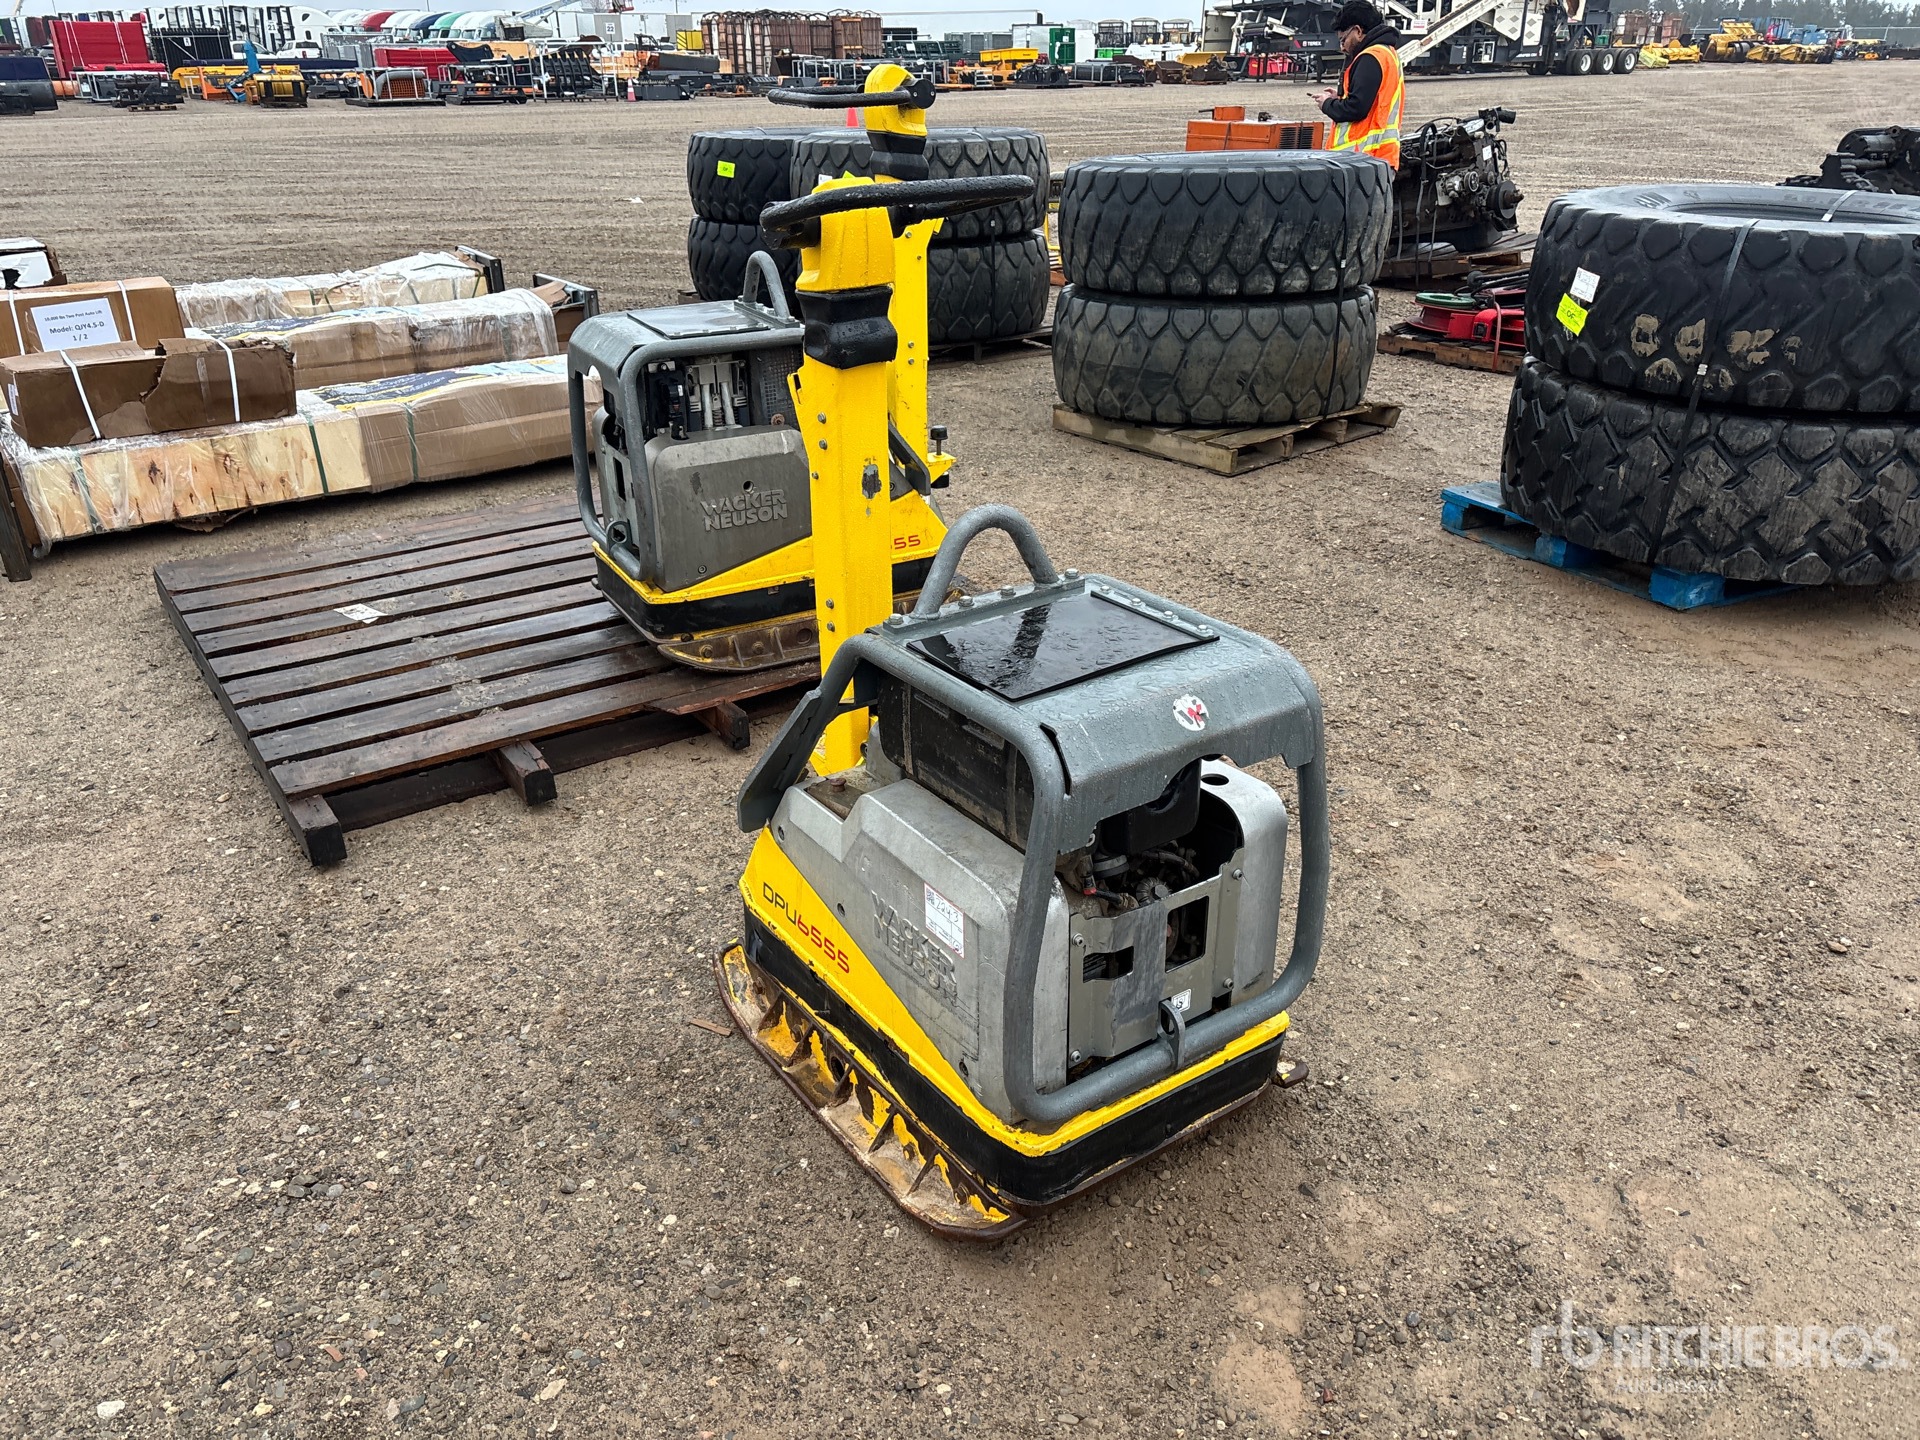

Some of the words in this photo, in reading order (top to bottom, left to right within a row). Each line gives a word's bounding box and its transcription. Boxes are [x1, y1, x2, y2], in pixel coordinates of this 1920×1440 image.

[49, 326, 74, 334] Model:
[74, 321, 105, 330] QJY4.5-D
[699, 489, 787, 516] WACKER
[703, 503, 788, 532] NEUSON
[762, 881, 850, 974] DPU6555
[870, 889, 957, 982] WACKER
[873, 914, 959, 1005] NEUSON
